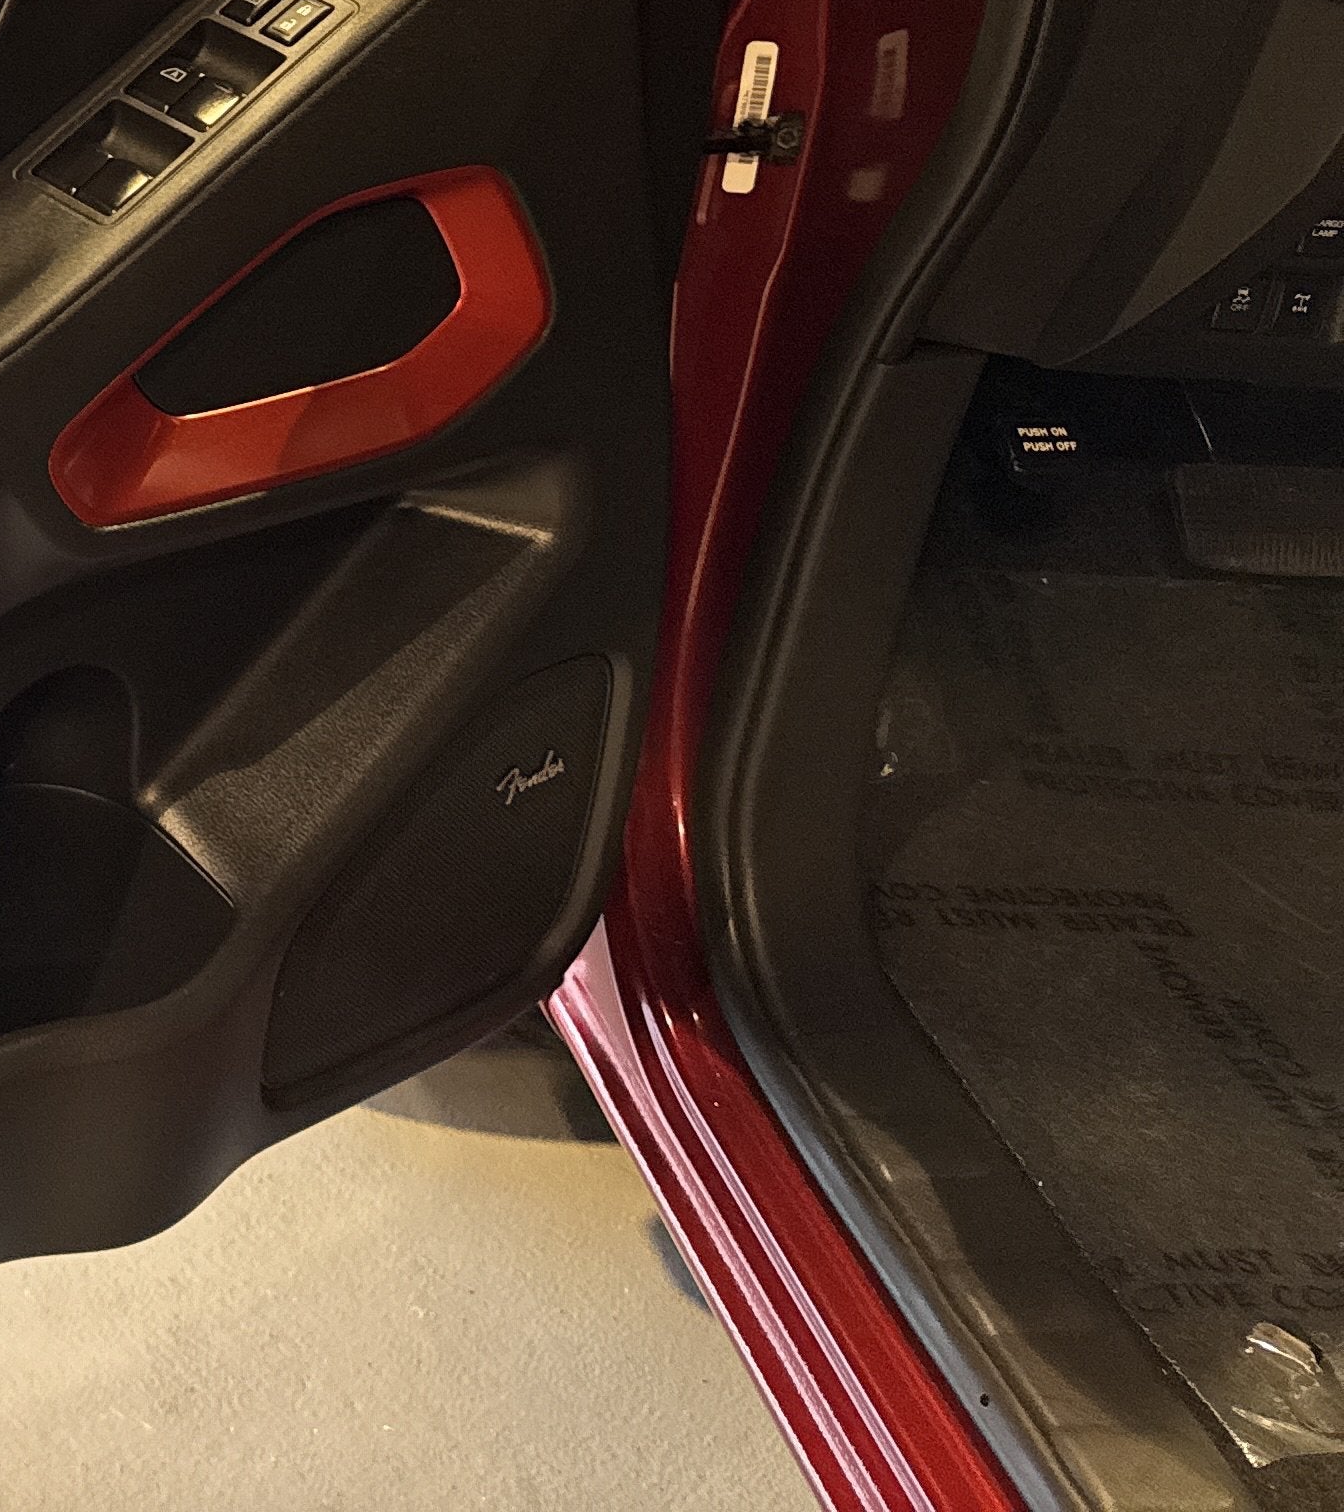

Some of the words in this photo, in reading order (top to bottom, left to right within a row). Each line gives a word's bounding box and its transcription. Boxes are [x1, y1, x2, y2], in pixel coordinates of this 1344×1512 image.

[1311, 228, 1339, 237] LAMP
[1017, 427, 1049, 437] PUSH
[1050, 427, 1069, 437] ON
[1022, 441, 1055, 452] PUSH
[1055, 441, 1077, 451] OFF
[496, 749, 565, 806] Fender
